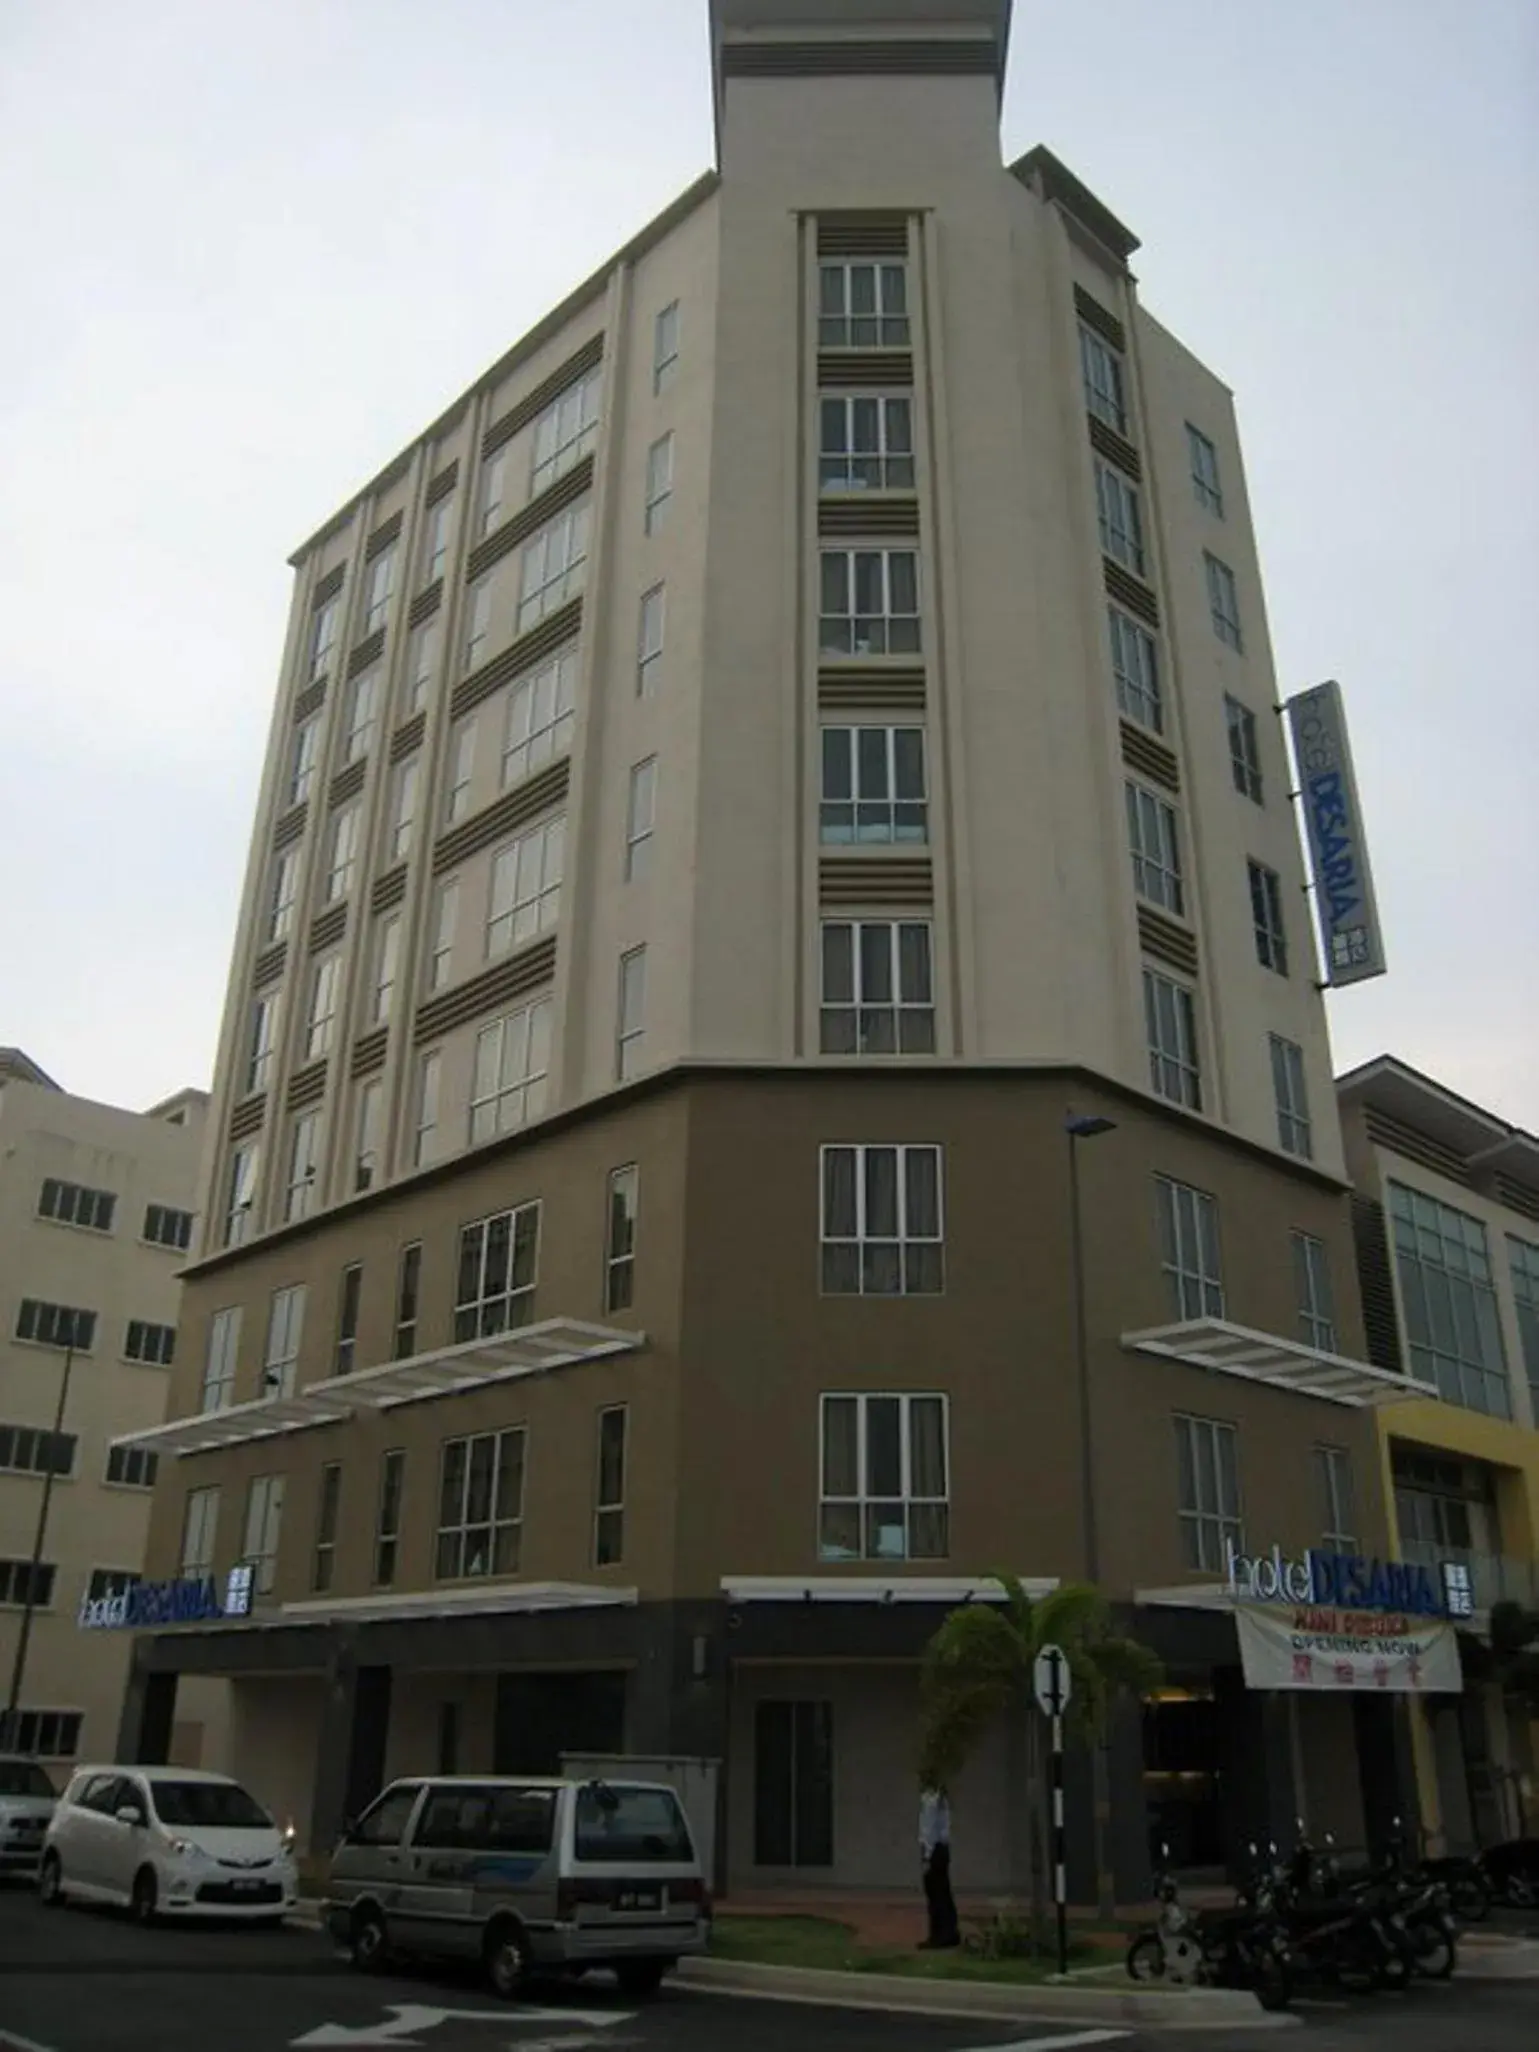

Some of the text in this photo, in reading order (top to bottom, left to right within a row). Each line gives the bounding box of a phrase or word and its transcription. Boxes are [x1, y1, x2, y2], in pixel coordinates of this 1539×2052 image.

[1310, 773, 1359, 924] DESARIA
[78, 1577, 131, 1630] hotel
[1226, 1535, 1313, 1605] hotel
[1312, 1550, 1442, 1615] DESARIA
[1291, 1634, 1370, 1653] OPENING
